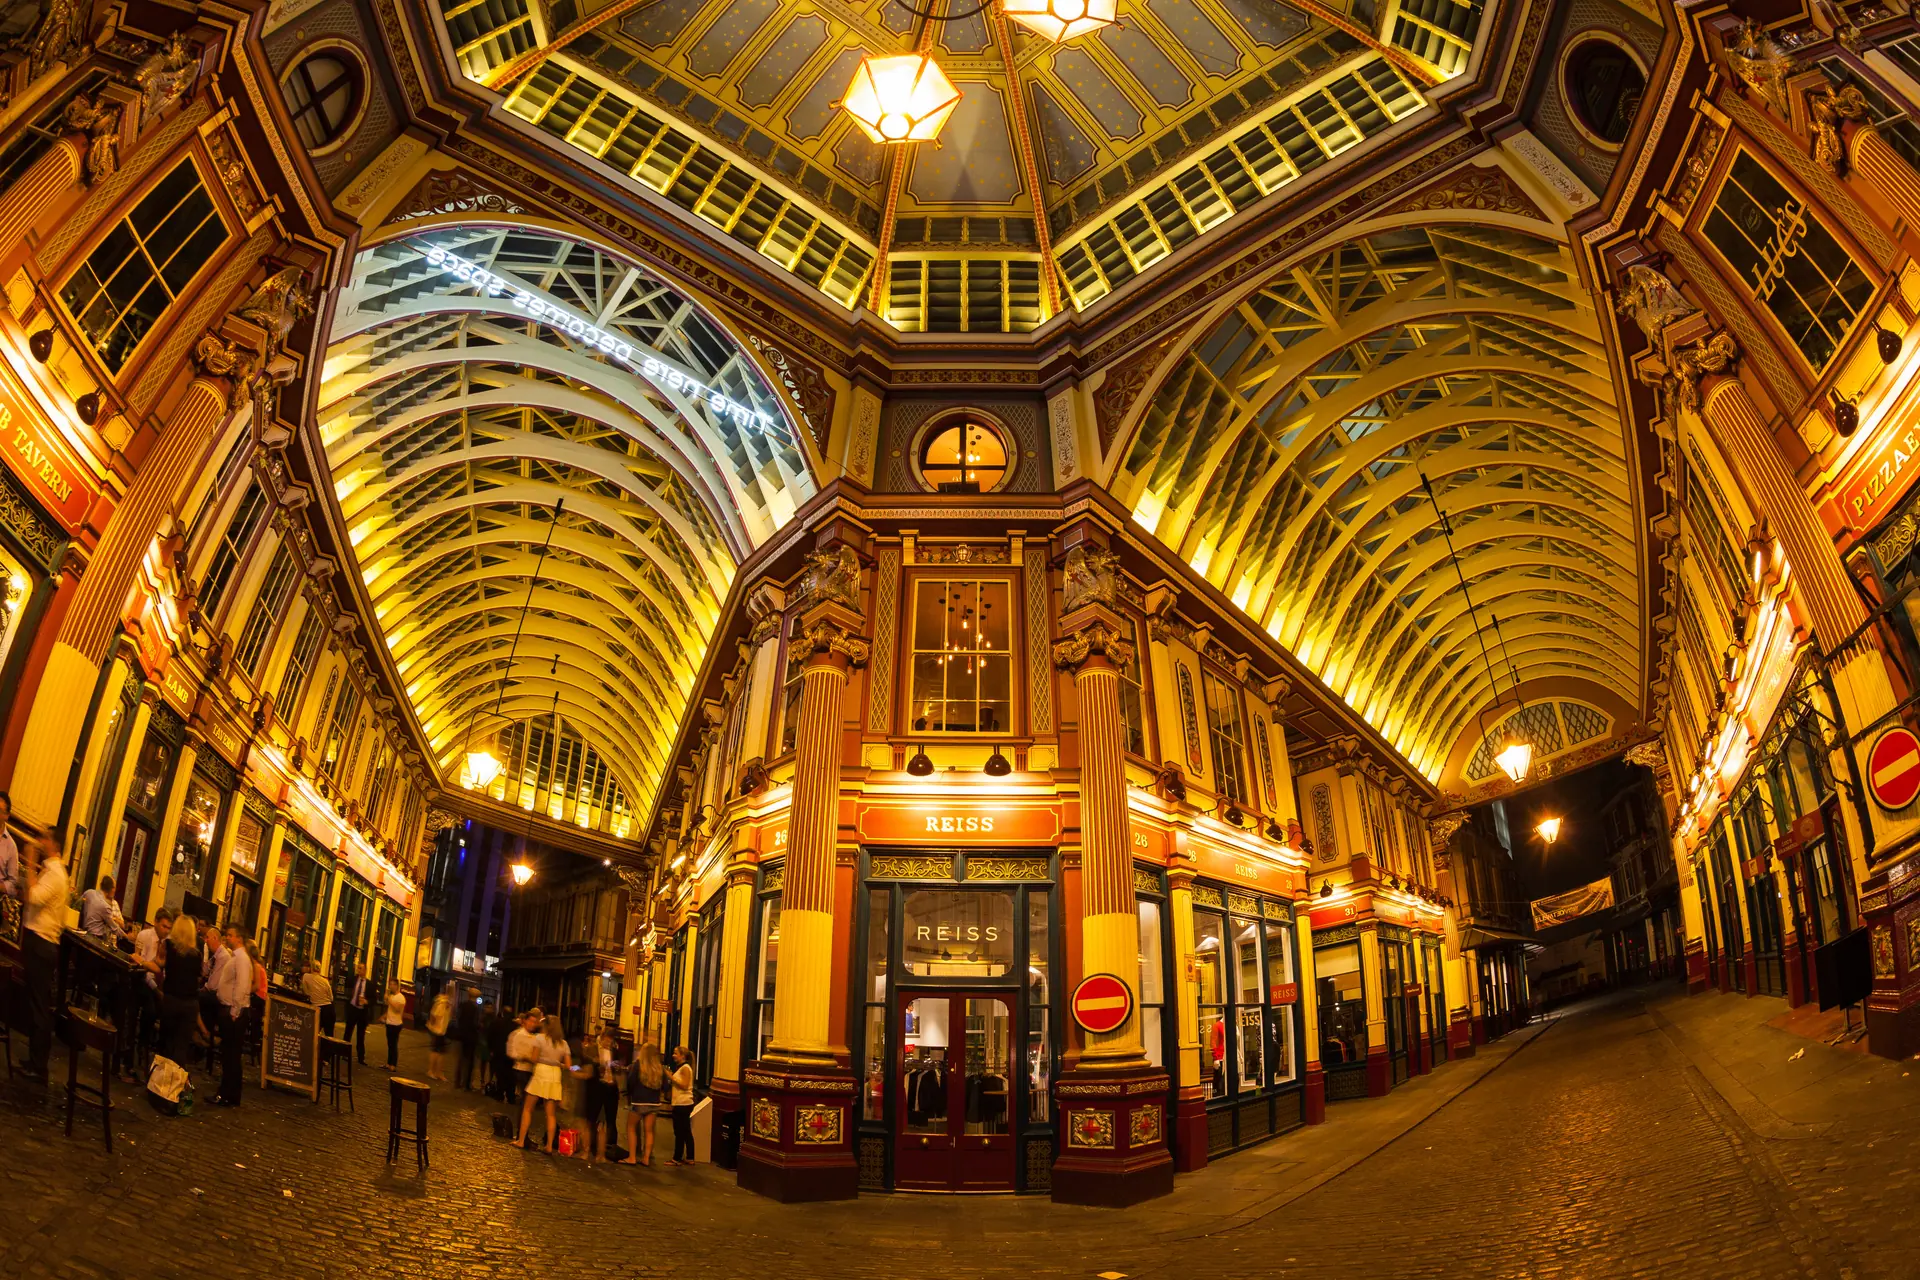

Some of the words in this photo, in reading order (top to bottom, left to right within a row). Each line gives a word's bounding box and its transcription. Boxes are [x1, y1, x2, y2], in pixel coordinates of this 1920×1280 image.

[543, 183, 764, 317] LEADENHALL
[1204, 201, 1349, 294] MARKET
[1751, 200, 1808, 302] LUC'S
[12, 426, 73, 504] TAVERN
[165, 674, 189, 704] LAMB
[212, 723, 236, 753] TAVERN
[925, 816, 994, 833] REISS
[774, 831, 788, 846] 26
[1134, 832, 1148, 848] 26
[1235, 864, 1258, 880] REISS
[1344, 907, 1355, 917] 31
[917, 926, 998, 941] REISS
[1272, 988, 1295, 1000] REISS
